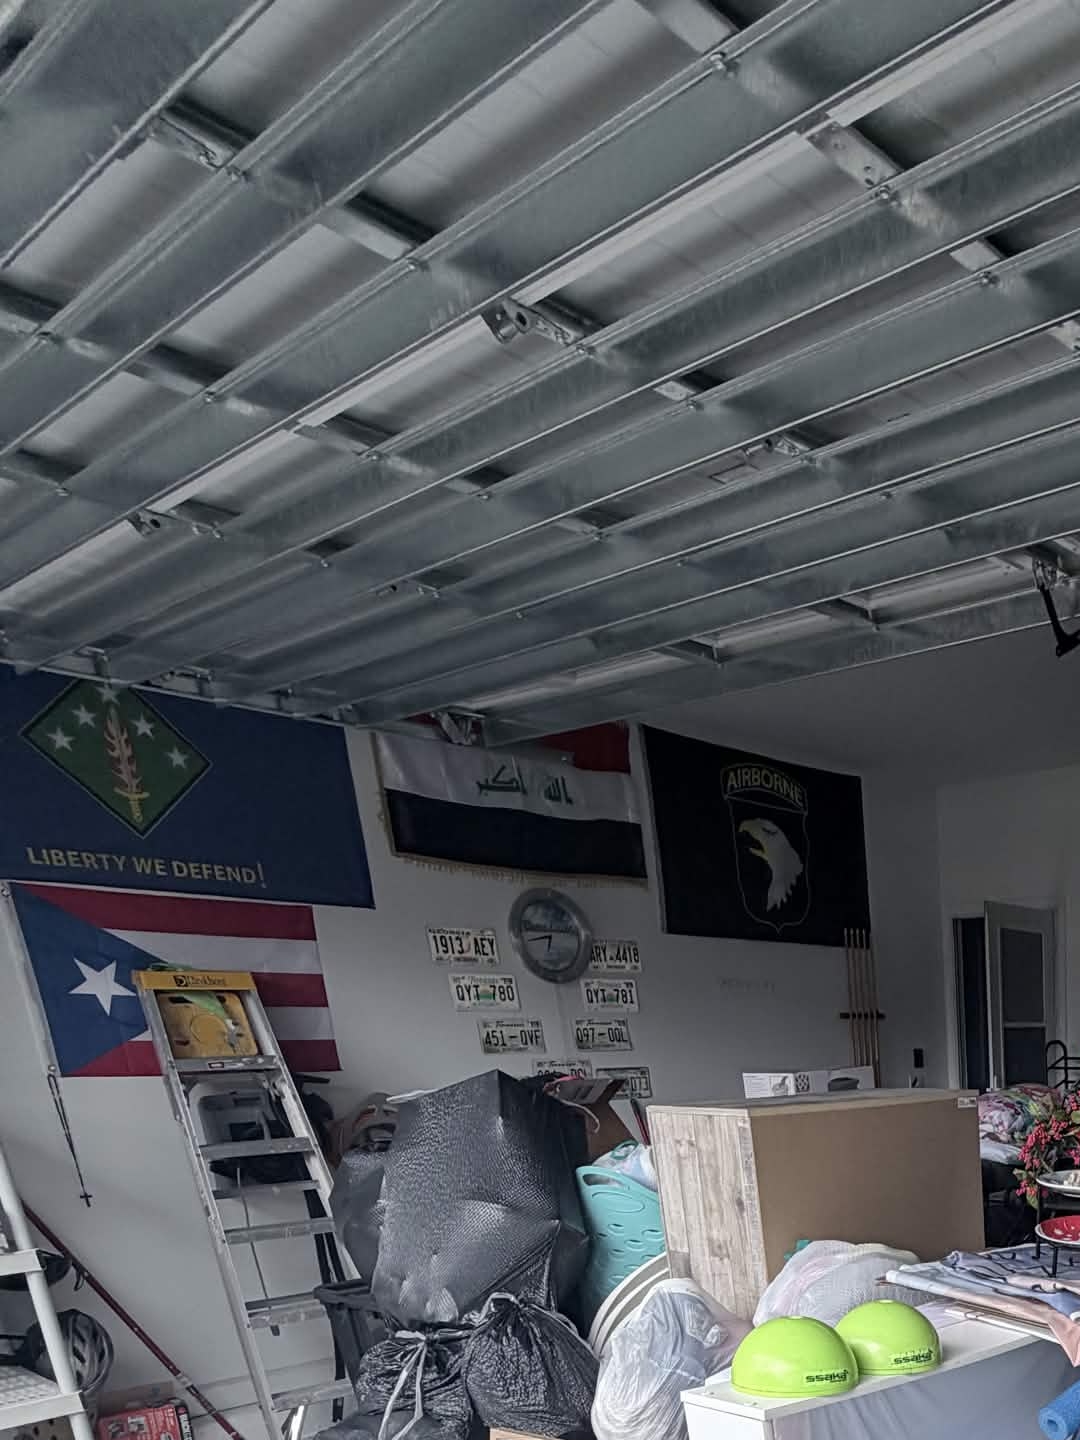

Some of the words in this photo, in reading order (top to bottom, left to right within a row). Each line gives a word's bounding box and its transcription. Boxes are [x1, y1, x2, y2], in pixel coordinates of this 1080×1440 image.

[727, 767, 803, 802] AIRBORNE
[26, 847, 126, 872] LIBERTY
[132, 856, 168, 876] WE
[171, 860, 267, 888] DEFEND!
[433, 935, 464, 955] 1913
[474, 938, 496, 956] AEY
[490, 985, 515, 1001] 780
[614, 989, 634, 1004] 781
